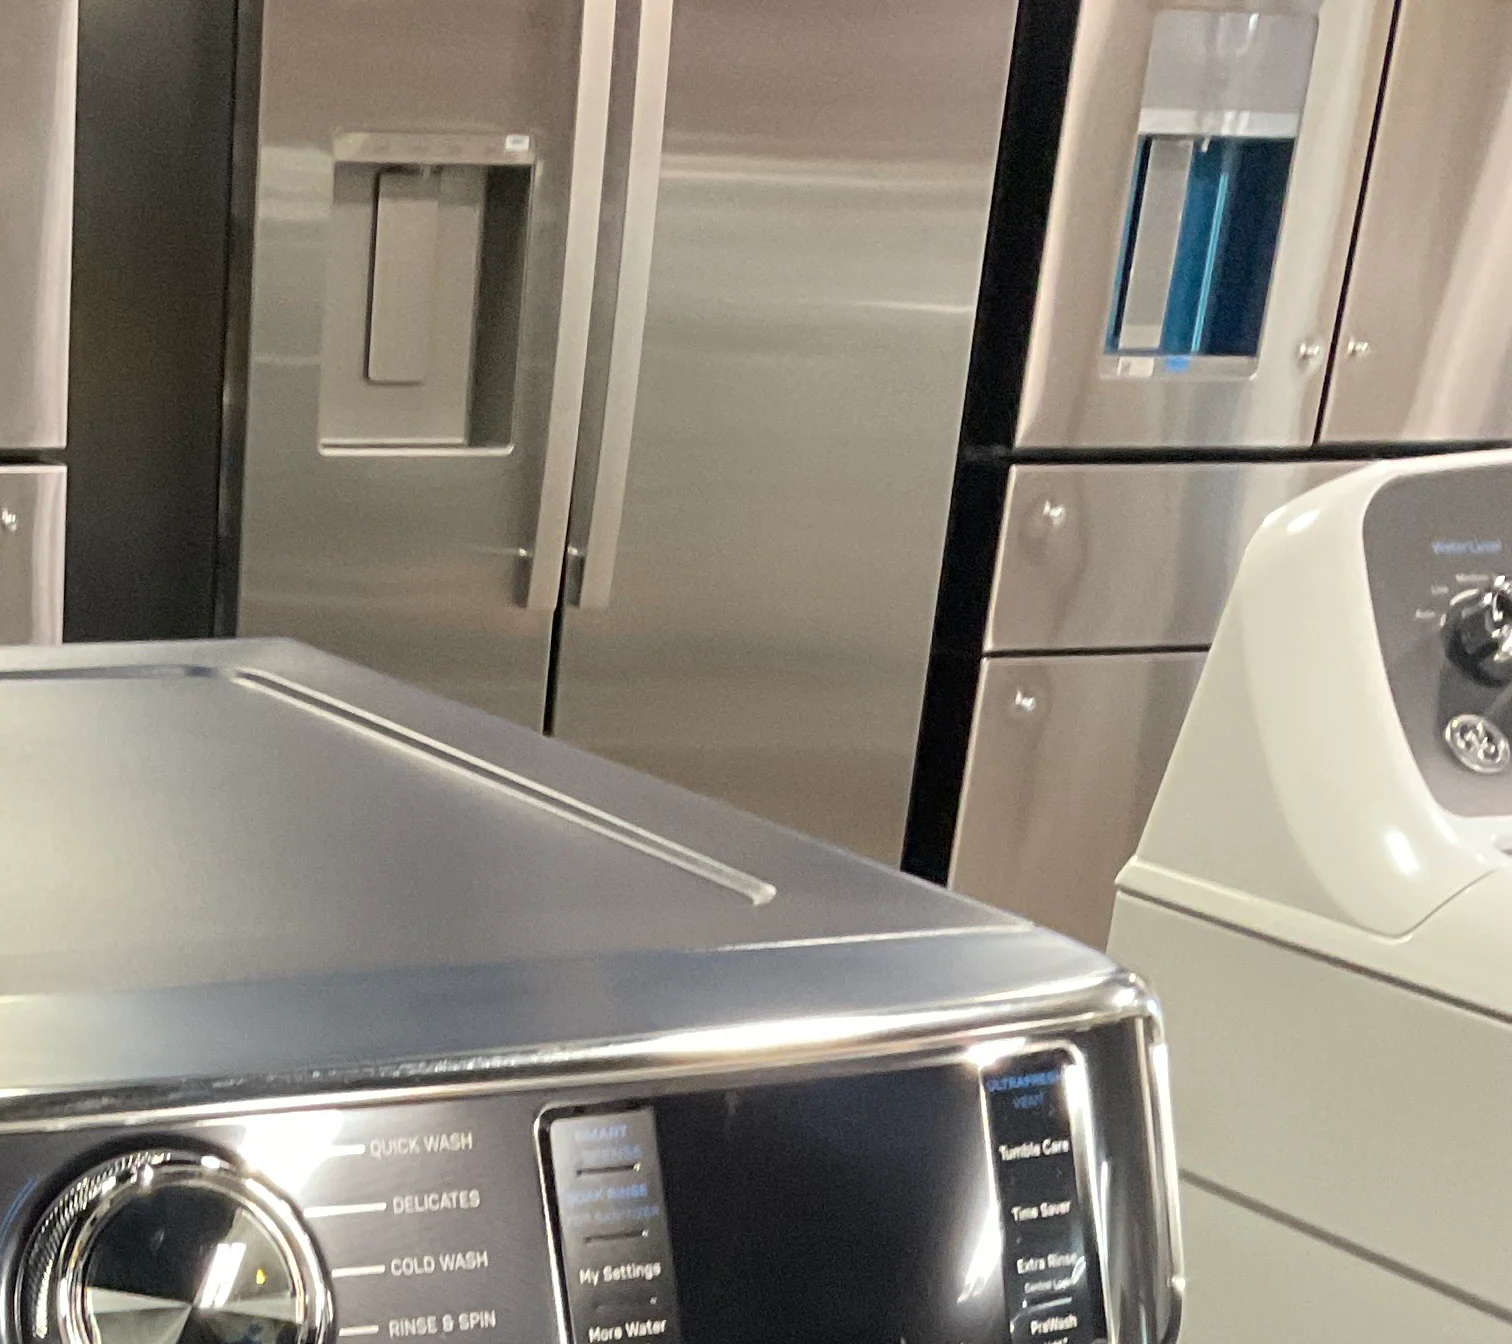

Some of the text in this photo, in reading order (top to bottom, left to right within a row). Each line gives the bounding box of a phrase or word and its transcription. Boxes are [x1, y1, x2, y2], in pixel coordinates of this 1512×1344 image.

[368, 1131, 473, 1158] QUICK WASH
[998, 1137, 1070, 1161] Tumble Care
[392, 1189, 481, 1215] DELICATES
[1011, 1201, 1071, 1221] Time Saver
[390, 1250, 489, 1277] COLD WASH
[579, 1261, 662, 1286] My Settings
[1016, 1257, 1045, 1274] Extra
[388, 1309, 496, 1339] RINSE & SPIN
[588, 1318, 667, 1343] More Water
